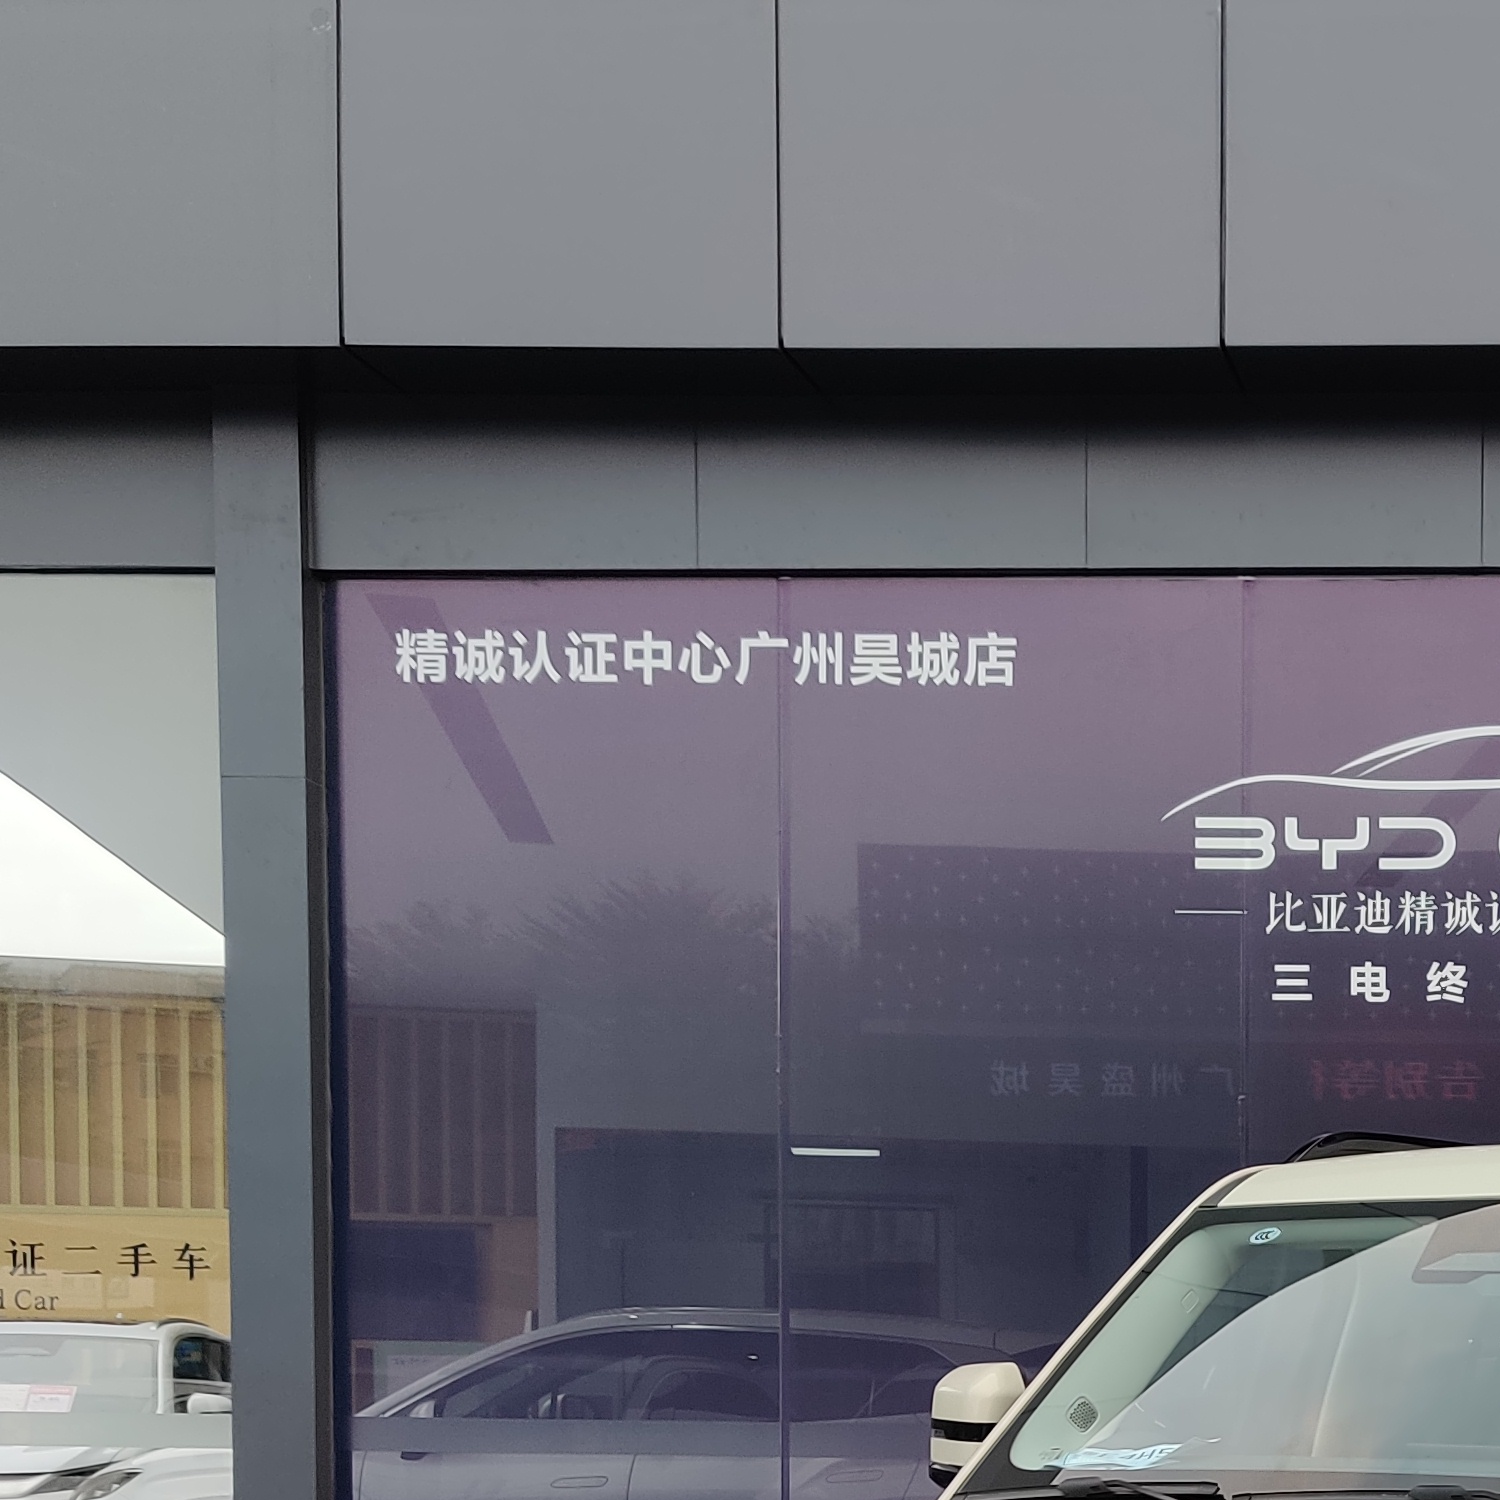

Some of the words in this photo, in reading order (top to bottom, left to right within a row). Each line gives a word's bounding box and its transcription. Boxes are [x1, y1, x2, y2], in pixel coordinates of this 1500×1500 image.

[394, 629, 1018, 687] 精诚认证中心广州昊城店
[1194, 816, 1457, 870] BYD
[4, 1238, 211, 1281] 证二手车
[14, 1288, 59, 1311] Car
